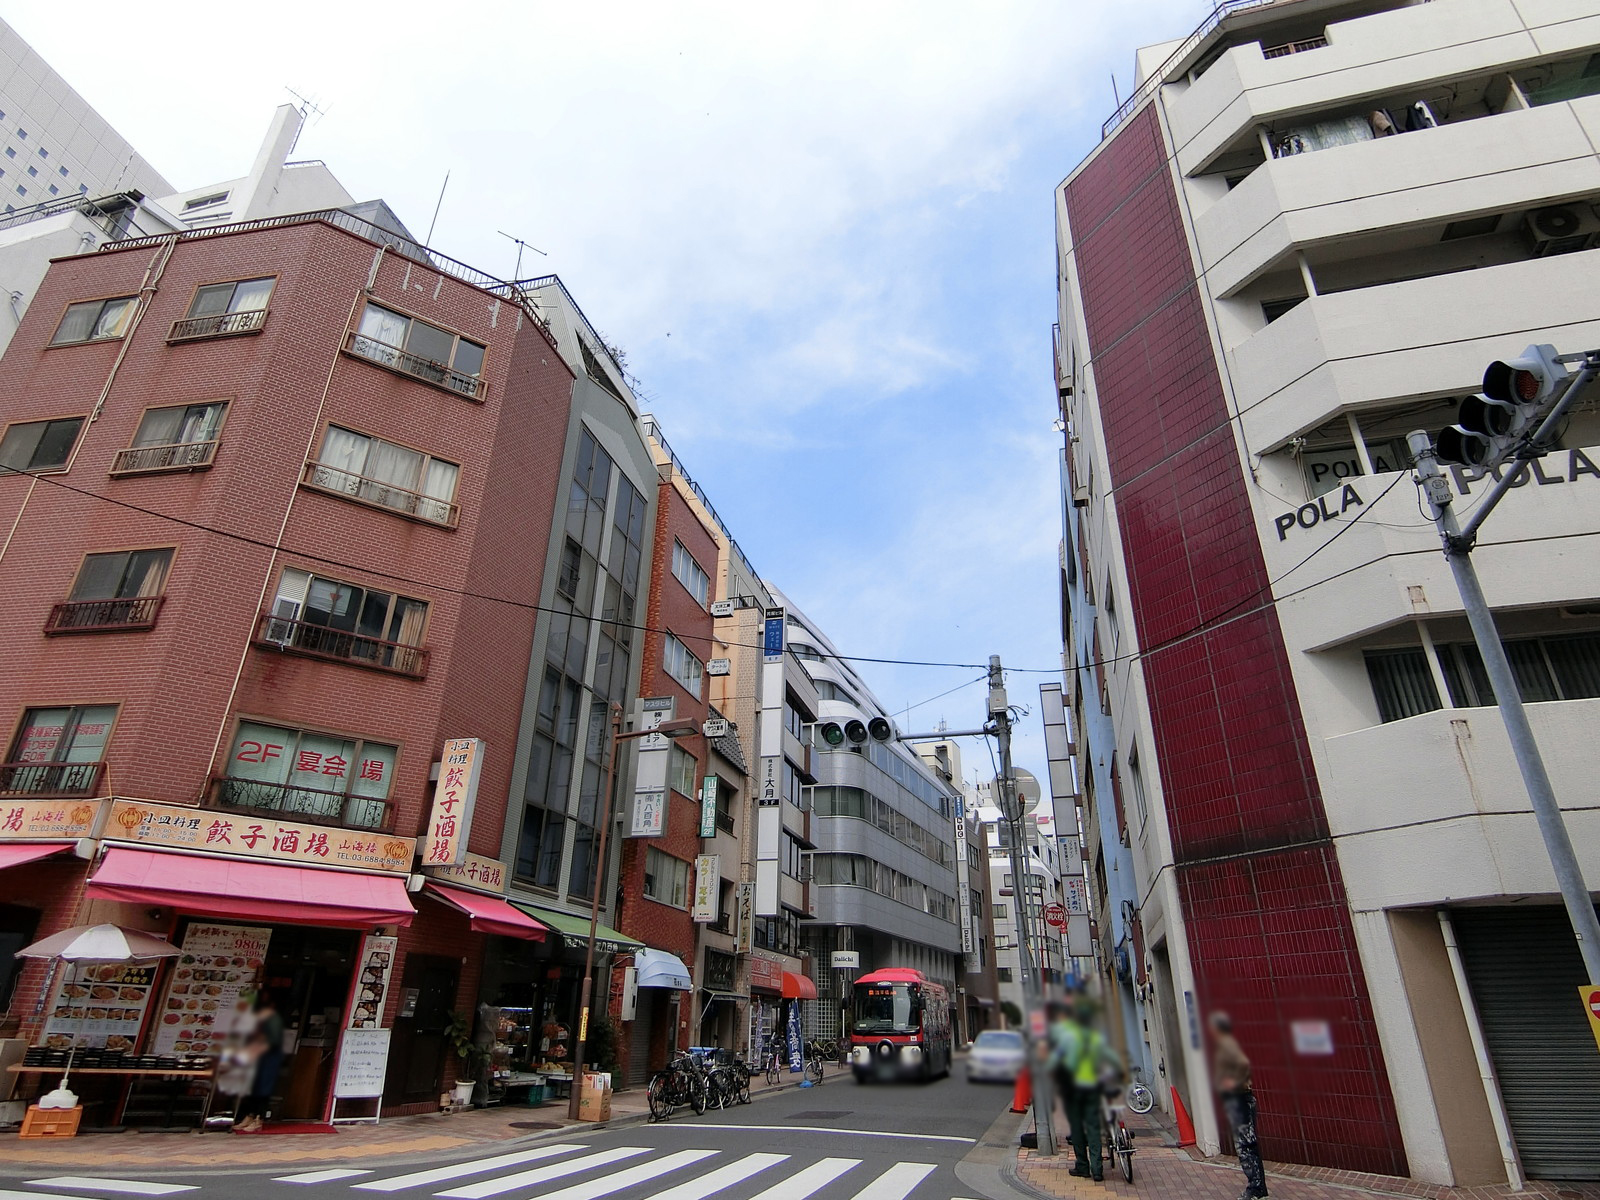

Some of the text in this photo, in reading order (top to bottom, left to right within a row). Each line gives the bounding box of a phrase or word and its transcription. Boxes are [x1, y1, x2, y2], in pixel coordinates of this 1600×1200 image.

[1450, 448, 1600, 495] POLA
[1275, 483, 1364, 542] POLA
[448, 753, 468, 765] 料理
[450, 741, 469, 751] 小皿
[236, 741, 385, 782] 2F 宴会場
[764, 778, 775, 798] 大月
[0, 807, 25, 832] 場
[143, 812, 201, 830] 小皿料理
[429, 767, 464, 863] 餃子酒場
[206, 820, 330, 858] 餃子酒場
[740, 885, 751, 921] おそば
[1046, 912, 1064, 921] 消火栓
